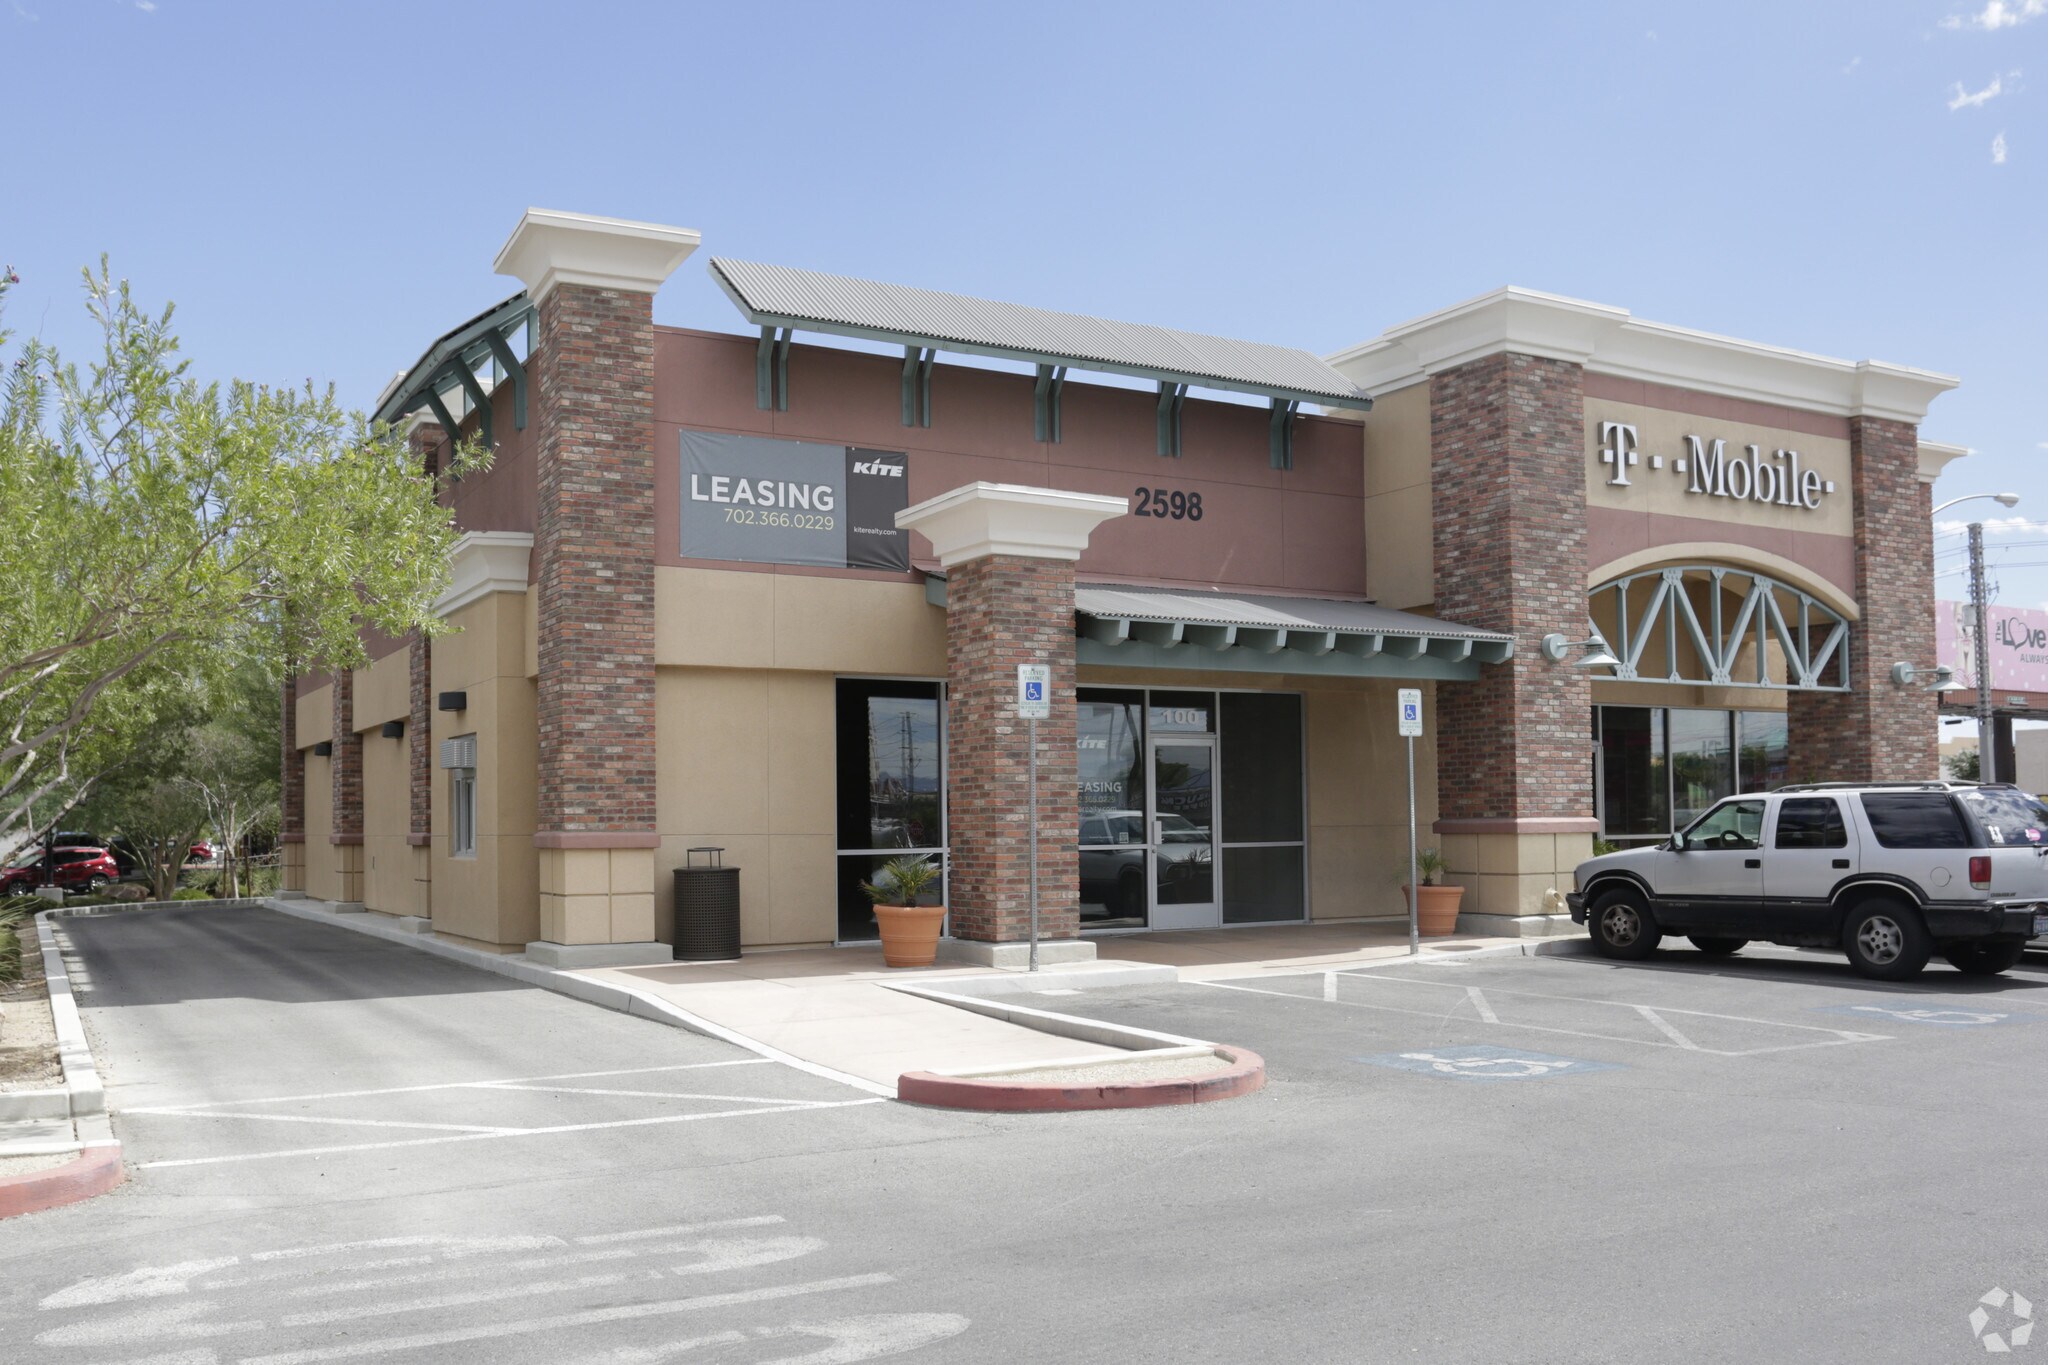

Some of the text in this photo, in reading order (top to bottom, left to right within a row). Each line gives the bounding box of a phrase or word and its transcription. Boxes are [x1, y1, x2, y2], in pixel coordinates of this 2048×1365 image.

[691, 474, 834, 511] LEASING
[1134, 487, 1203, 521] 2598
[723, 508, 834, 530] 702.366.0229
[853, 526, 897, 536] kiterealty.com
[1161, 709, 1200, 724] 100
[1077, 781, 1122, 793] EASING
